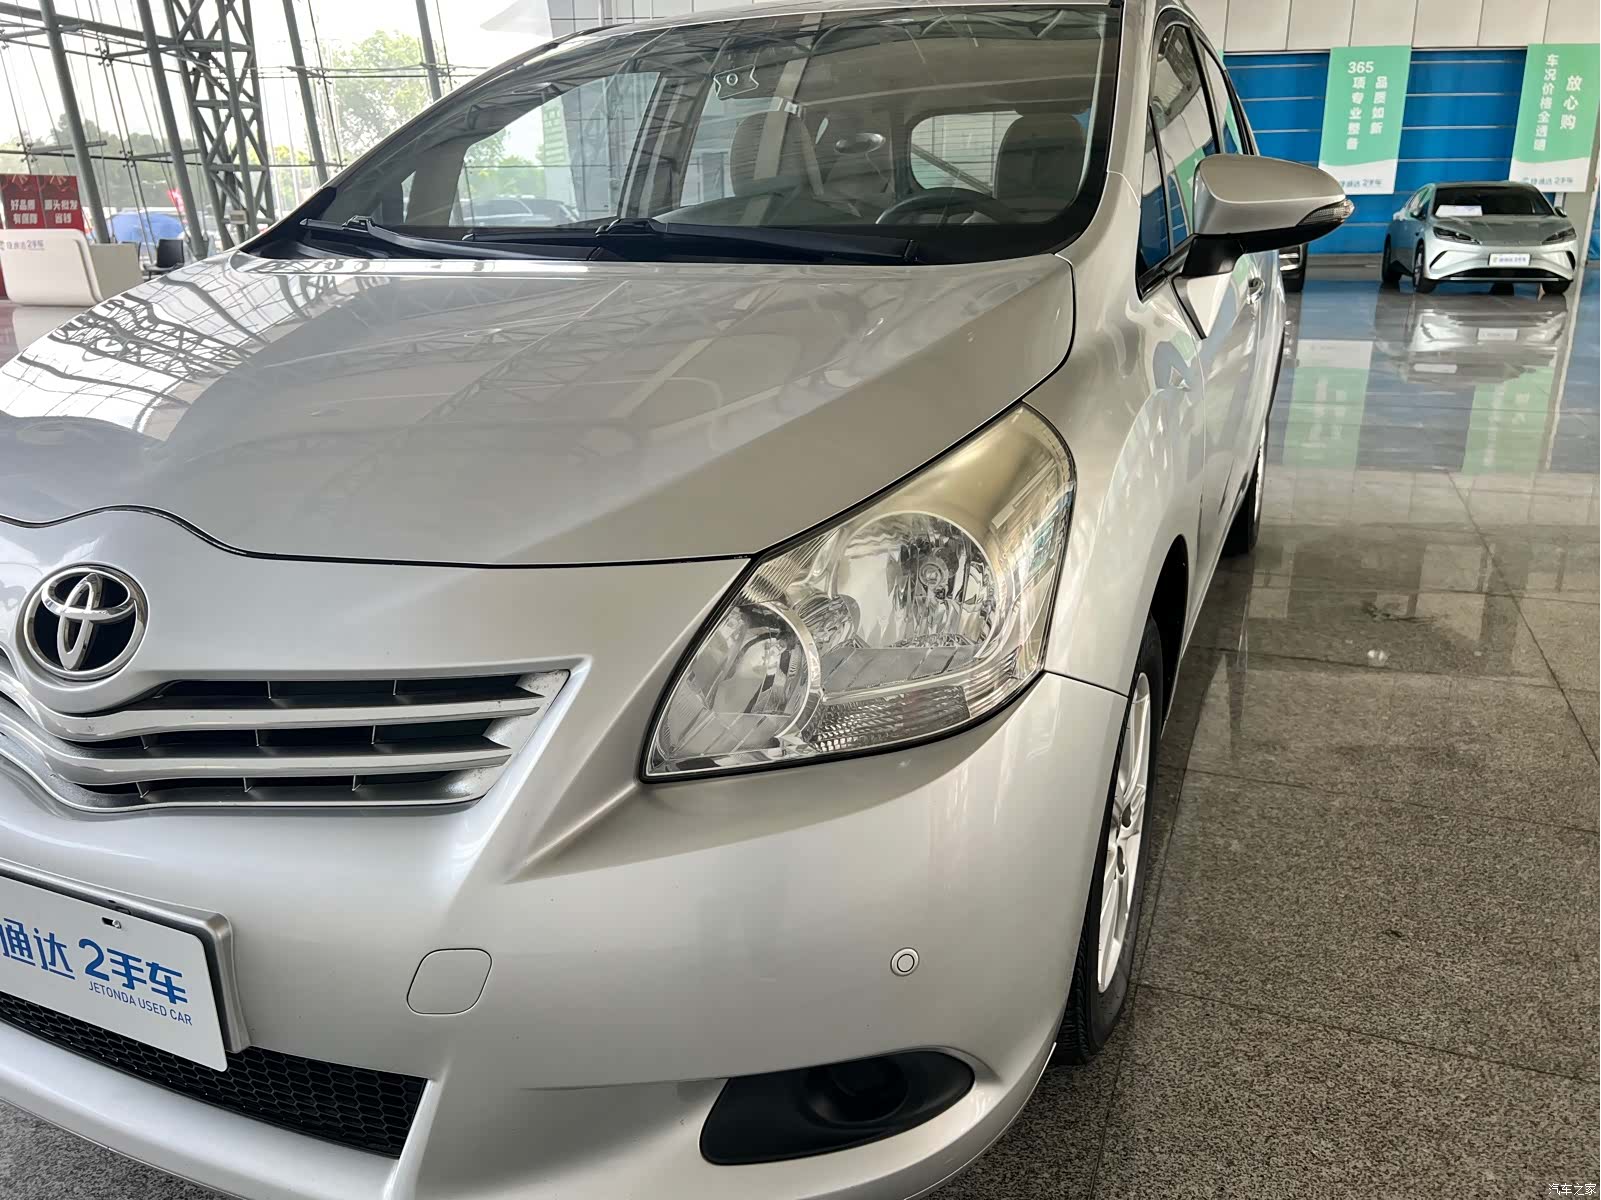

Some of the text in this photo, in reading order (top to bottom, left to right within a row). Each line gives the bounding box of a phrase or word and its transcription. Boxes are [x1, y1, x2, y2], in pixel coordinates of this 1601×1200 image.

[1348, 61, 1374, 74] 365
[1560, 75, 1583, 130] 放心购
[79, 938, 188, 1005] 2手车
[88, 980, 193, 1026] JETONDA USED CAR
